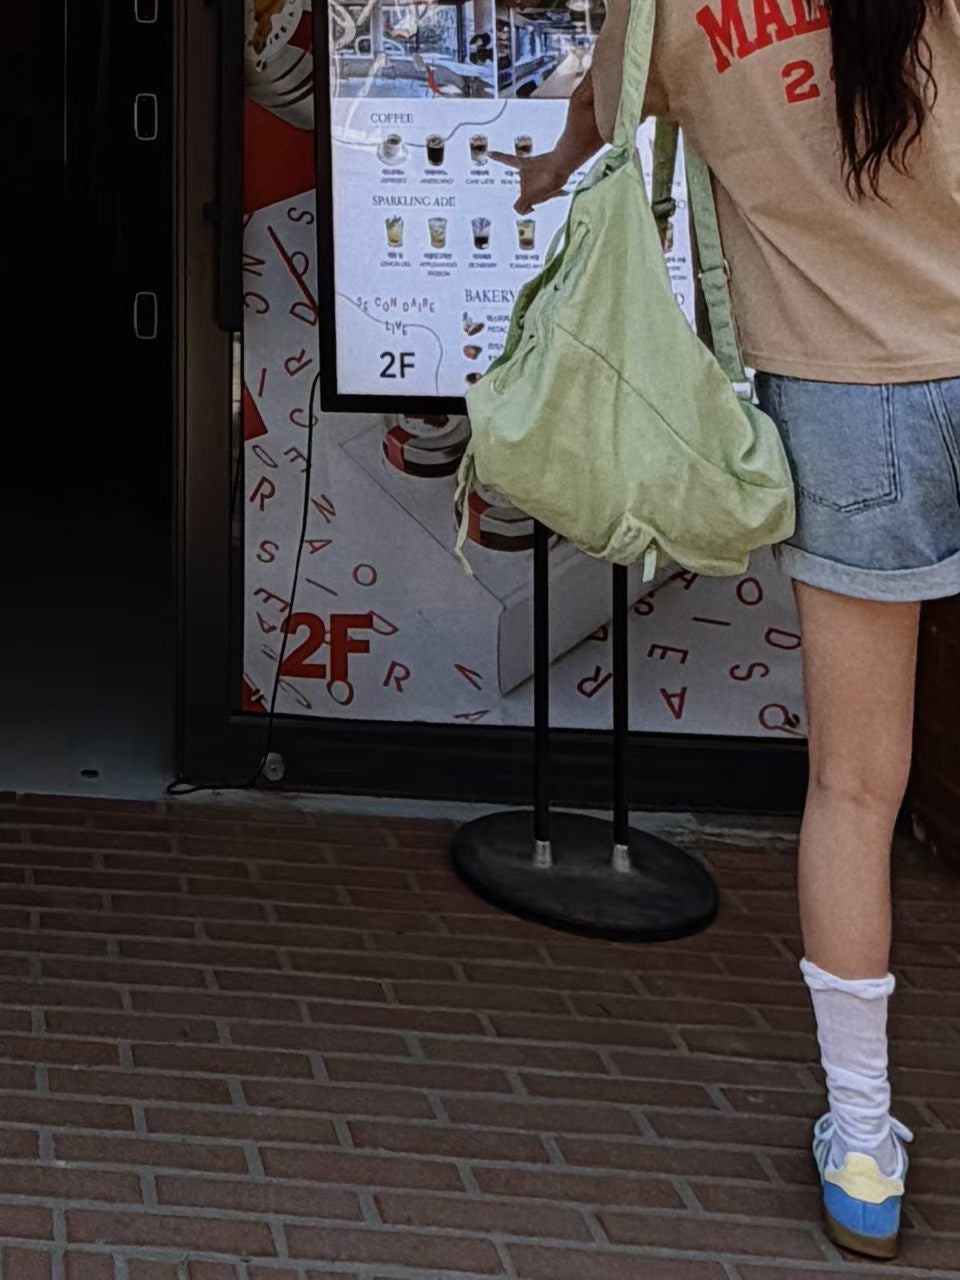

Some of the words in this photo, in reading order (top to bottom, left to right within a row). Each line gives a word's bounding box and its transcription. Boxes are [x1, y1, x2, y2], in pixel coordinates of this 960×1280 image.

[780, 59, 835, 104] 2
[370, 112, 414, 124] COFFEE
[372, 195, 431, 208] SPARKLING
[433, 195, 456, 208] ADE
[465, 288, 516, 304] BAKERY
[379, 351, 416, 379] 2F
[279, 611, 374, 683] 2F
